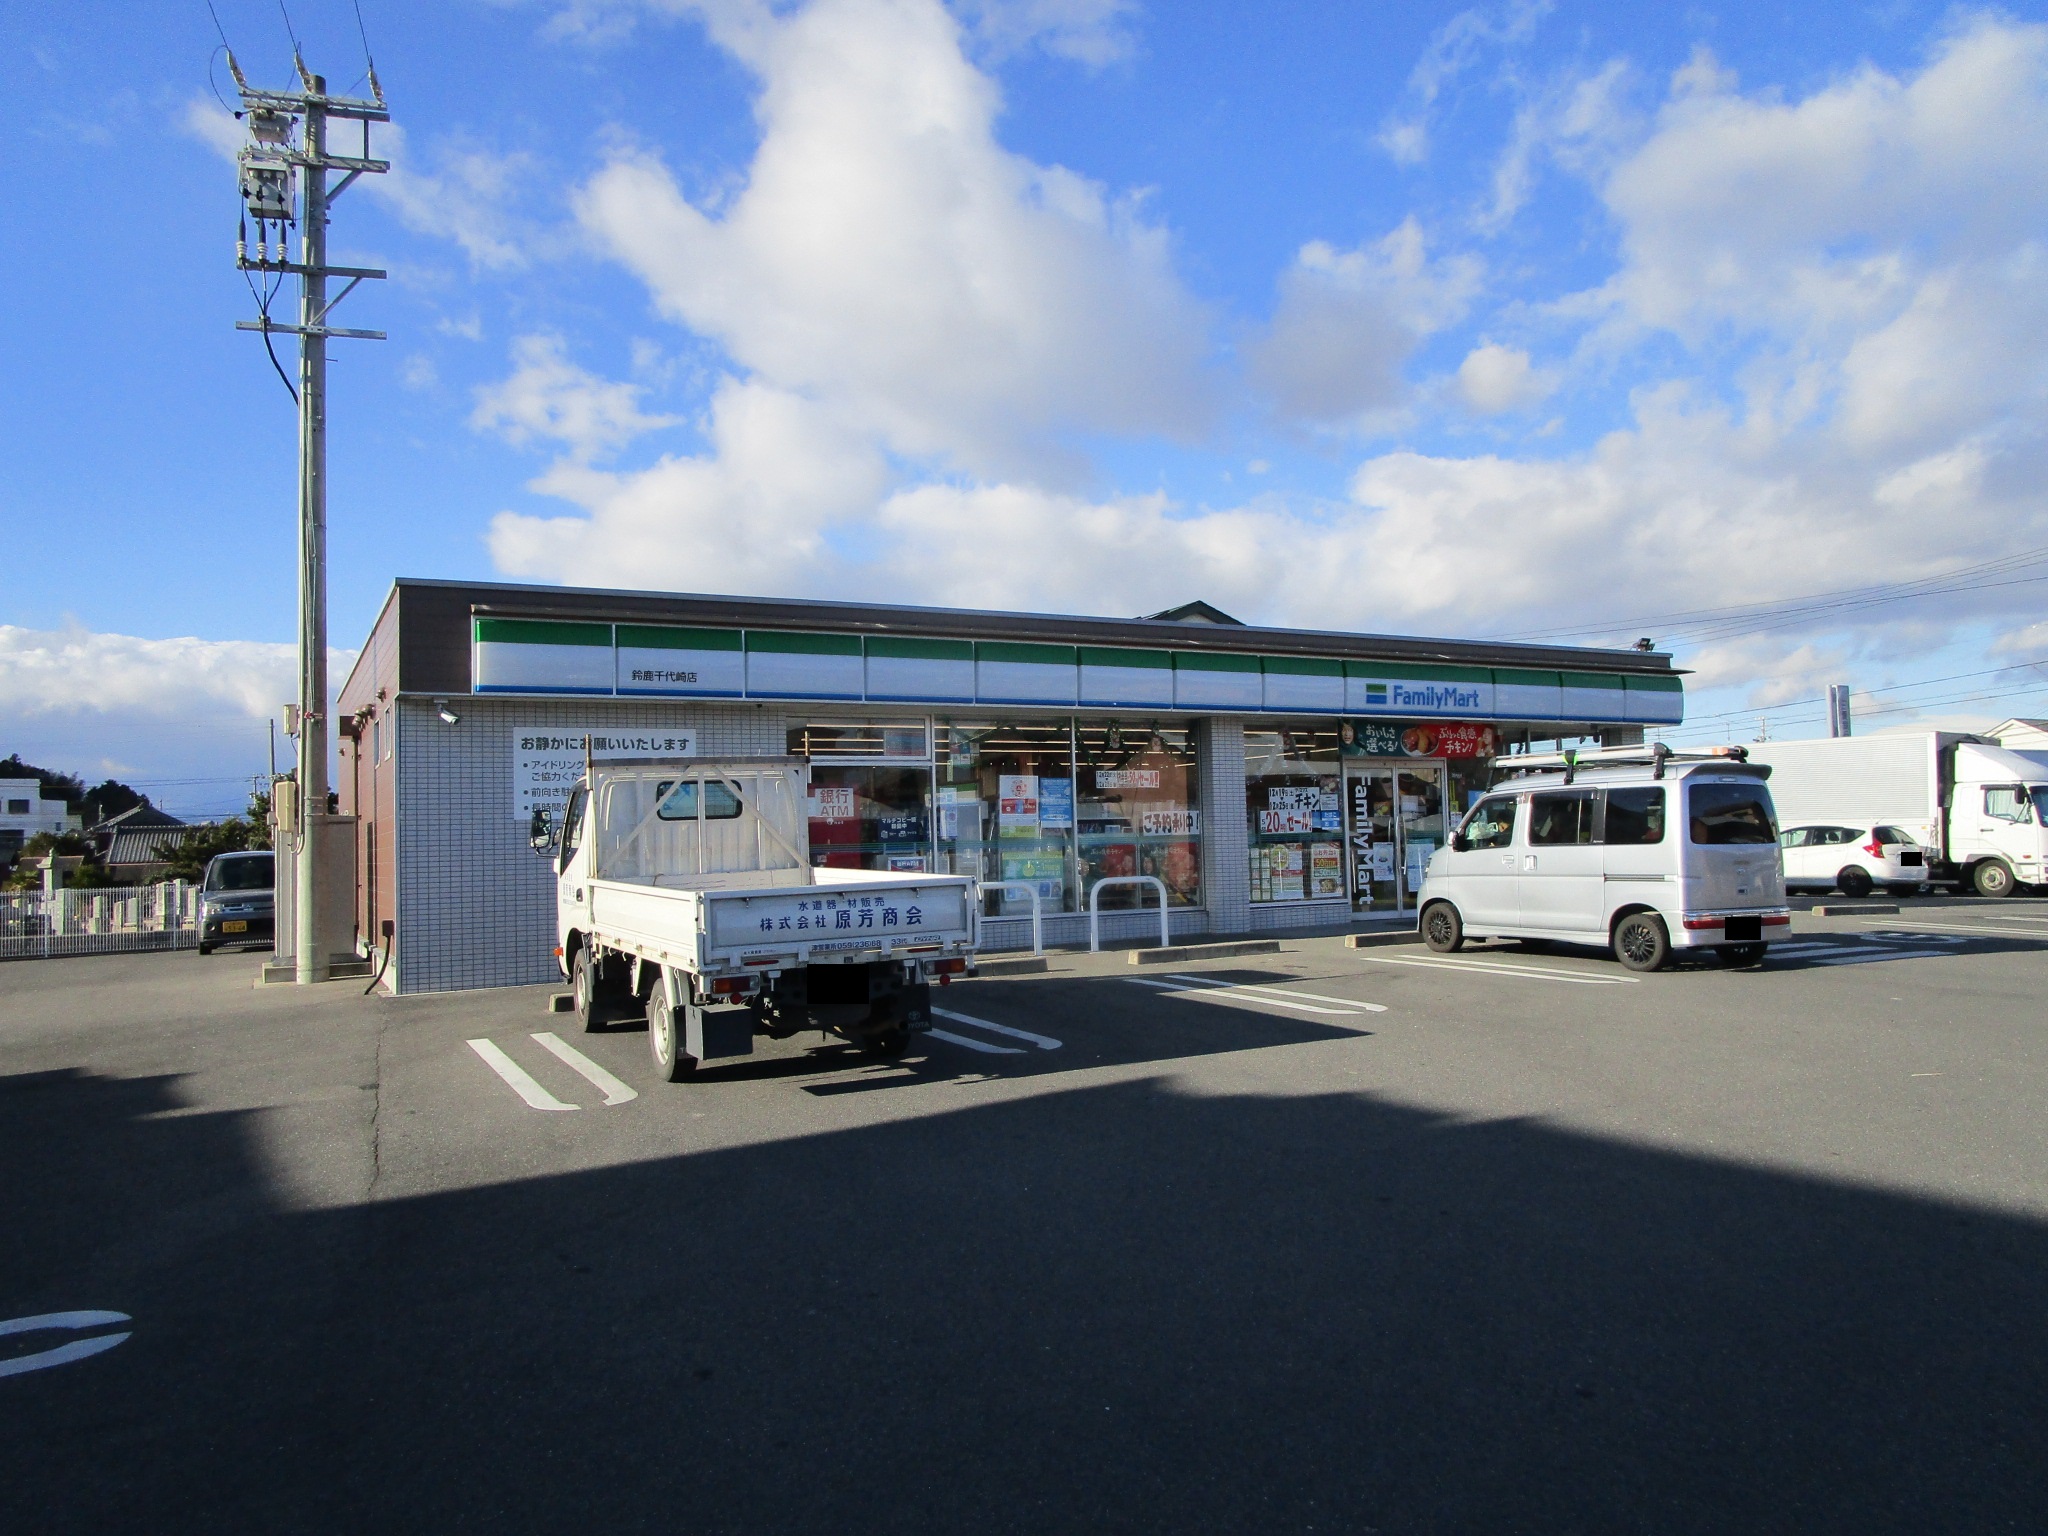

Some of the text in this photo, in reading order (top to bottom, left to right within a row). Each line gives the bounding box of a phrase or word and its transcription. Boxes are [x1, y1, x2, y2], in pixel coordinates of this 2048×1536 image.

[631, 669, 698, 683] 鈴鹿千代崎店
[1393, 685, 1479, 709] FamilyMart
[1365, 724, 1396, 738] おいしさ
[521, 736, 690, 751] お静かにお願いいたします
[1444, 740, 1473, 754] チキン!
[531, 771, 586, 782] ご協力くだ
[820, 789, 849, 804] 銀行
[1294, 793, 1319, 810] チキン
[820, 805, 849, 817] ATM
[1353, 771, 1375, 905] FamilyMart
